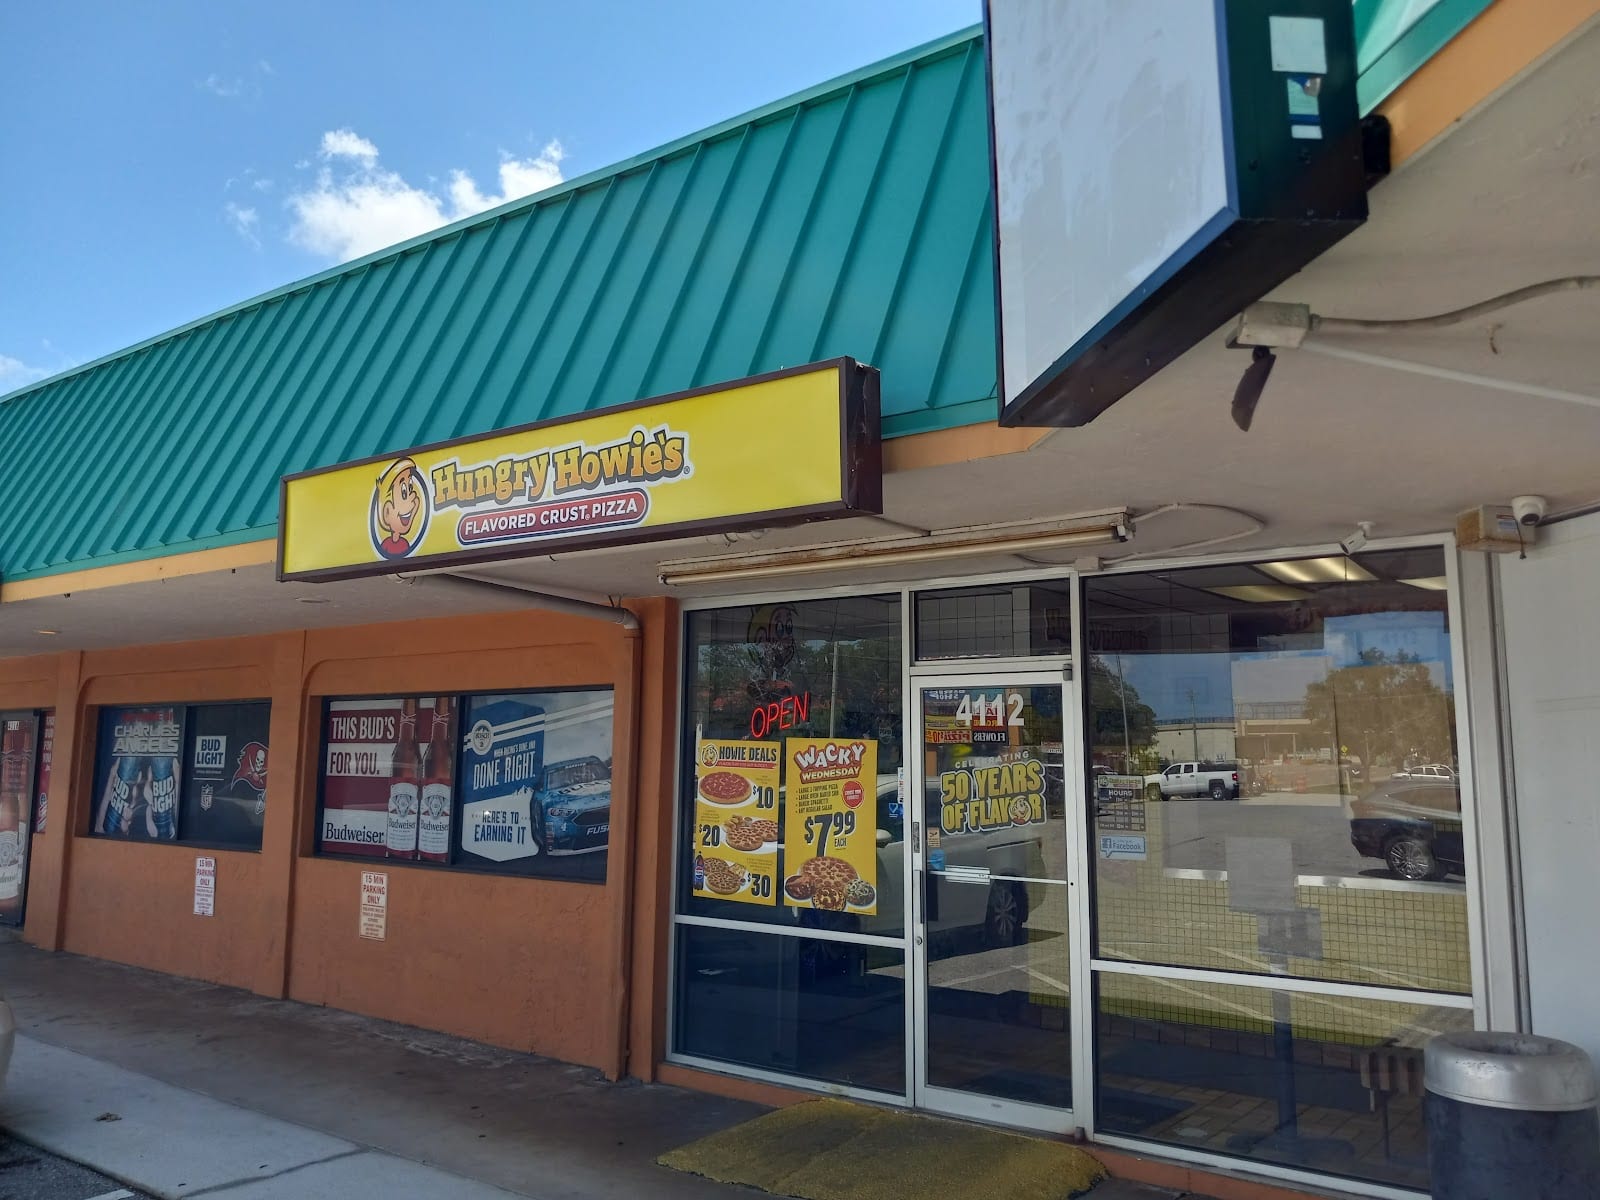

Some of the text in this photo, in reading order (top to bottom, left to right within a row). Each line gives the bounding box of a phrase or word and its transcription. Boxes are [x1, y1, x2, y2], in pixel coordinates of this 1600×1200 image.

[432, 430, 685, 511] Hungry Howie's
[465, 497, 637, 535] FLAVORED CRUST PIZZA
[751, 691, 809, 738] OPEN
[956, 692, 1025, 727] 4112
[332, 716, 395, 740] THIS BUD'S
[200, 738, 221, 751] BUD
[719, 746, 777, 761] HOWIE DEALS
[196, 752, 223, 765] LIGHT
[329, 752, 380, 775] FOR YOU.
[796, 744, 864, 768] WACKY
[473, 751, 536, 790] DONE RIGHT.
[802, 766, 860, 781] WEDNESDAY
[942, 760, 1041, 803] 50 YEARS
[153, 775, 175, 797] BUD
[752, 785, 774, 808] $10
[111, 791, 130, 814] GHT
[388, 817, 416, 829] Budweiser
[482, 811, 519, 824] HERE'S TO
[942, 803, 967, 830] OF
[325, 822, 385, 843] Budweiser
[474, 824, 527, 845] EARNING IT
[699, 824, 720, 847] $20
[834, 838, 847, 847] EACH
[1112, 842, 1141, 850] Facebook
[363, 885, 385, 895] PARKING
[365, 875, 384, 885] 15 MIN
[747, 872, 771, 898] $30
[367, 895, 380, 904] ONLY
